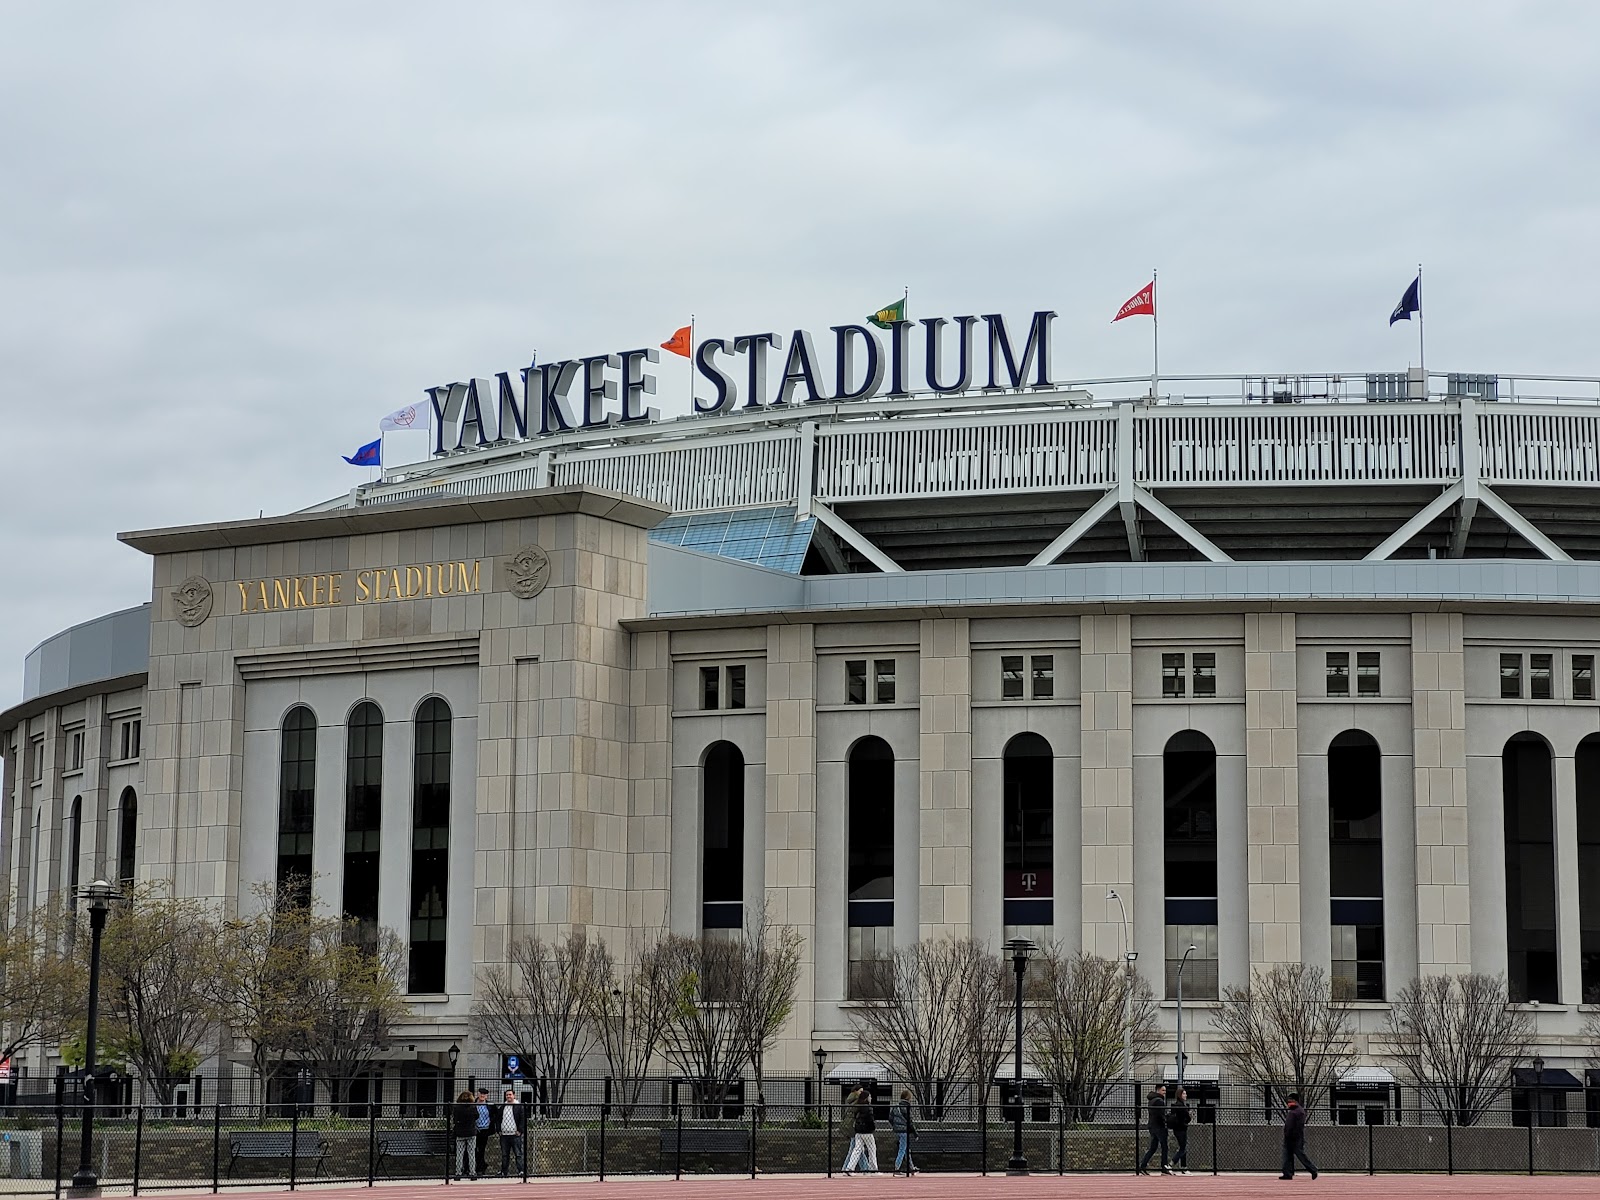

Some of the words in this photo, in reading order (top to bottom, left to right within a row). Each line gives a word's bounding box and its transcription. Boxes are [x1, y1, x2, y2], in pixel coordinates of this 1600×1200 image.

[424, 348, 660, 455] YANKEE
[694, 310, 1058, 413] STADIUM
[238, 573, 342, 614] YANKEE
[355, 560, 481, 604] STADIUM
